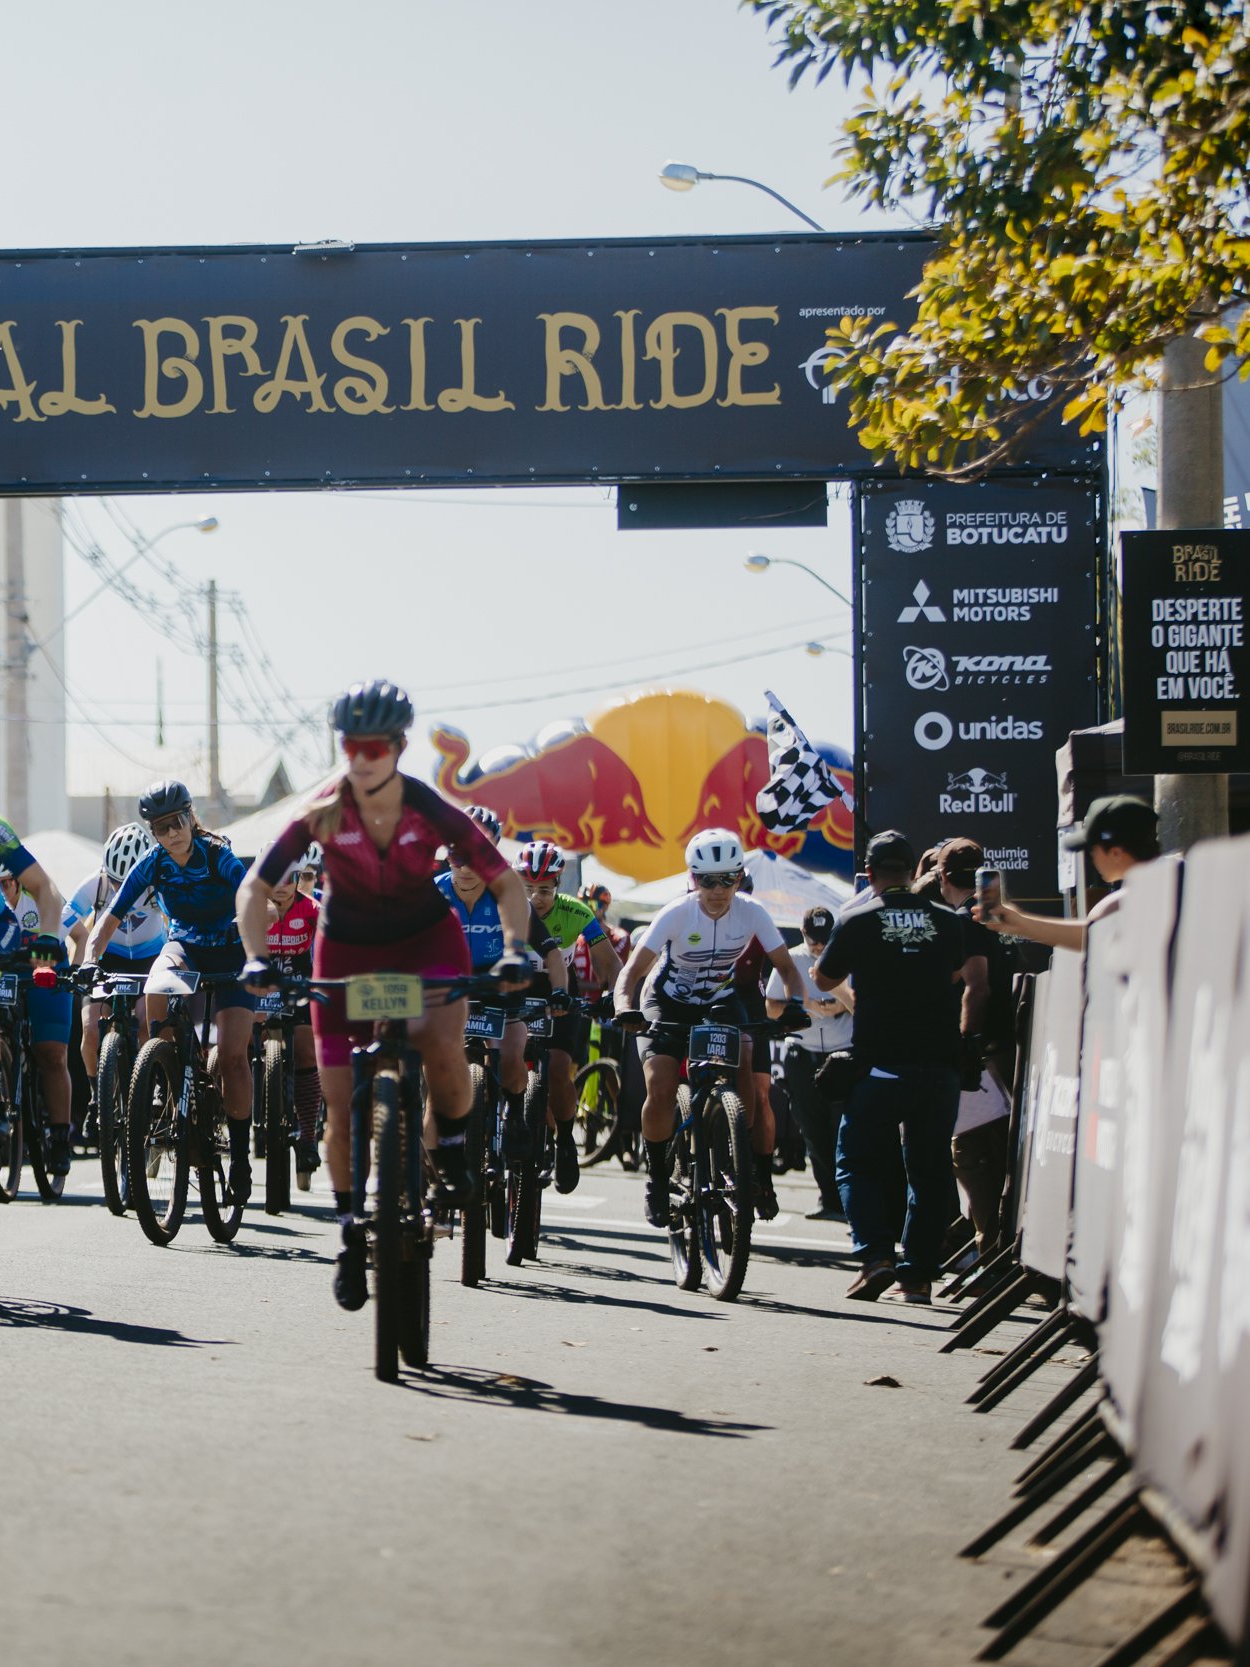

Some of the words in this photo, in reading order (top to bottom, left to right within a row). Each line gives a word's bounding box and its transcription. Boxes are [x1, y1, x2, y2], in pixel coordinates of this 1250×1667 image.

[799, 305, 865, 318] apresentado
[867, 306, 886, 318] por
[132, 313, 516, 420] BRASIL
[534, 304, 783, 414] RIDE
[946, 512, 1040, 526] PREFEITURA
[1046, 511, 1067, 525] DE
[946, 526, 1068, 545] BOTUCATU
[1172, 545, 1223, 564] BRASIL
[1174, 562, 1221, 582] RIDE
[952, 587, 1059, 604] MITSUBISHI
[953, 606, 1031, 622] MOTORS
[1151, 597, 1243, 622] DESPERTE
[1151, 625, 1163, 648] O
[1167, 623, 1244, 648] GIGANTE
[1165, 650, 1200, 674] QUE
[1205, 647, 1231, 673] HÁ
[954, 675, 1048, 685] BICYCLES
[1156, 677, 1184, 700] EM
[1188, 673, 1240, 700] VOCÊ.
[958, 715, 1044, 740] unidas
[939, 794, 975, 813] Red
[978, 793, 1013, 813] Bull
[984, 847, 1029, 860] lquimia
[996, 859, 1030, 870] saúde
[886, 912, 924, 928] TEAM
[362, 997, 407, 1011] KELLYN
[464, 1021, 493, 1032] AMILA
[710, 1033, 727, 1044] 1203
[707, 1043, 726, 1056] IARA
